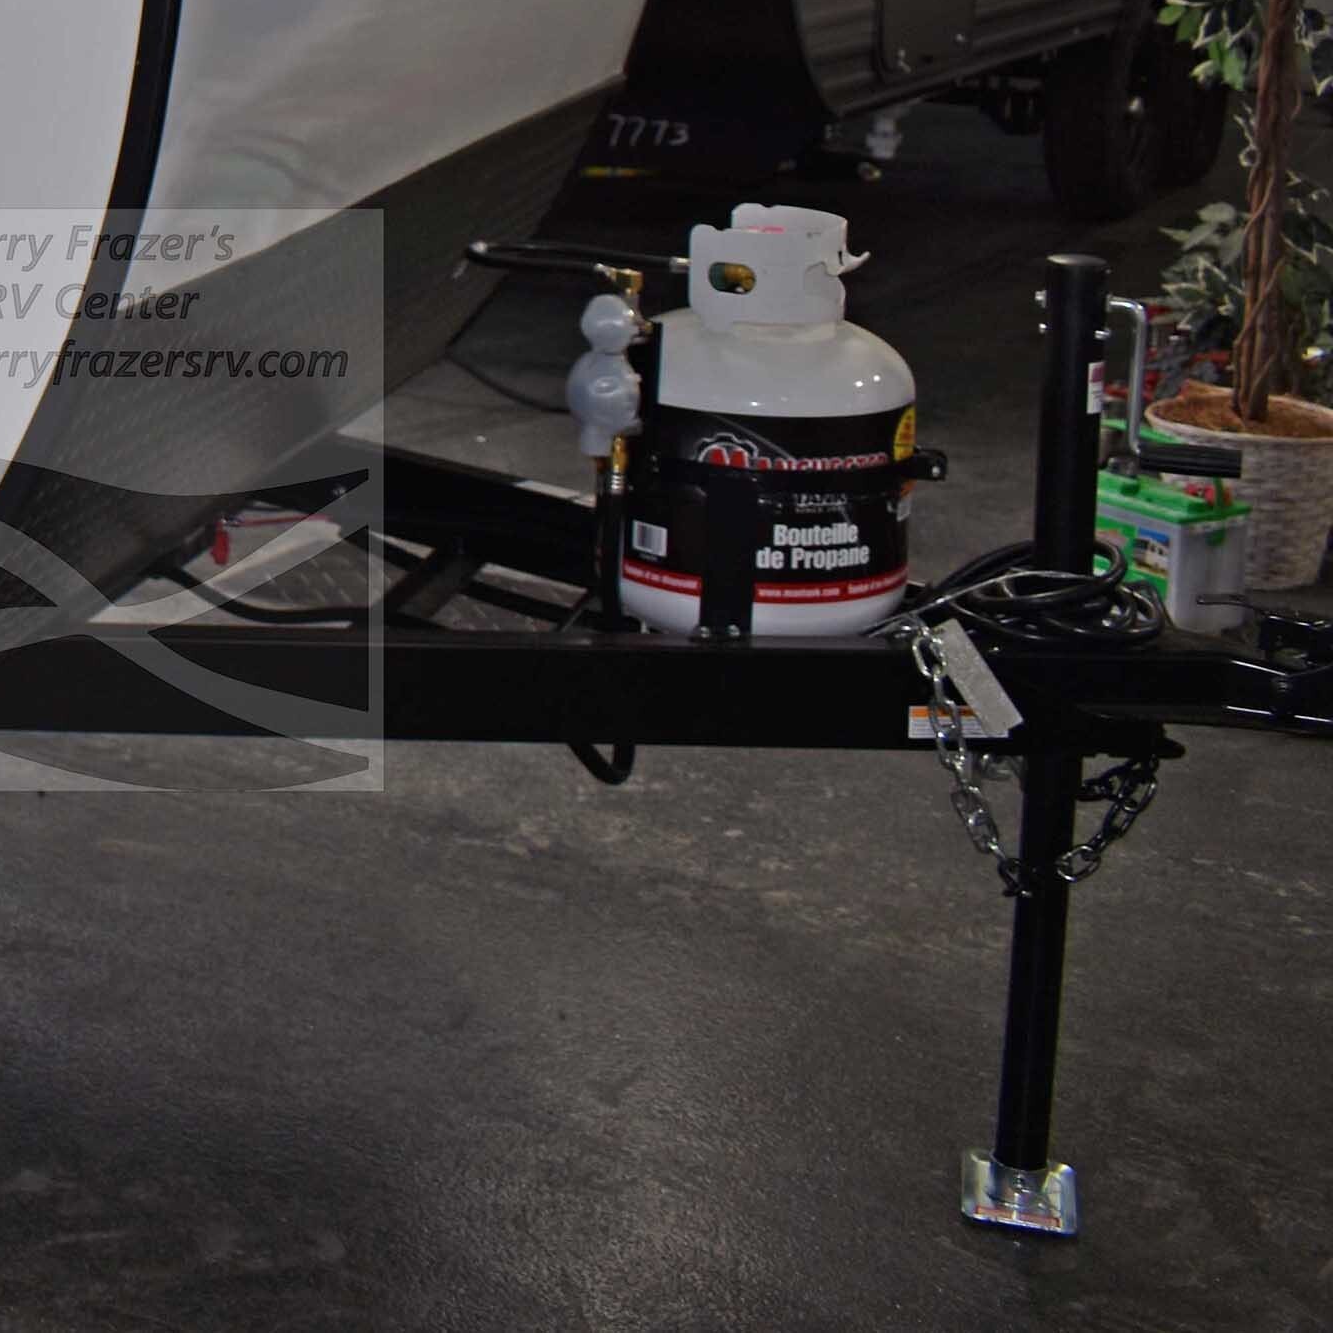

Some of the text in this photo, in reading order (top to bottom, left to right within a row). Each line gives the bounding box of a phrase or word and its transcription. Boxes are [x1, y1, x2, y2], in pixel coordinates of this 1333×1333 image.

[773, 523, 859, 547] Bouteille
[756, 546, 871, 571] de Propane
